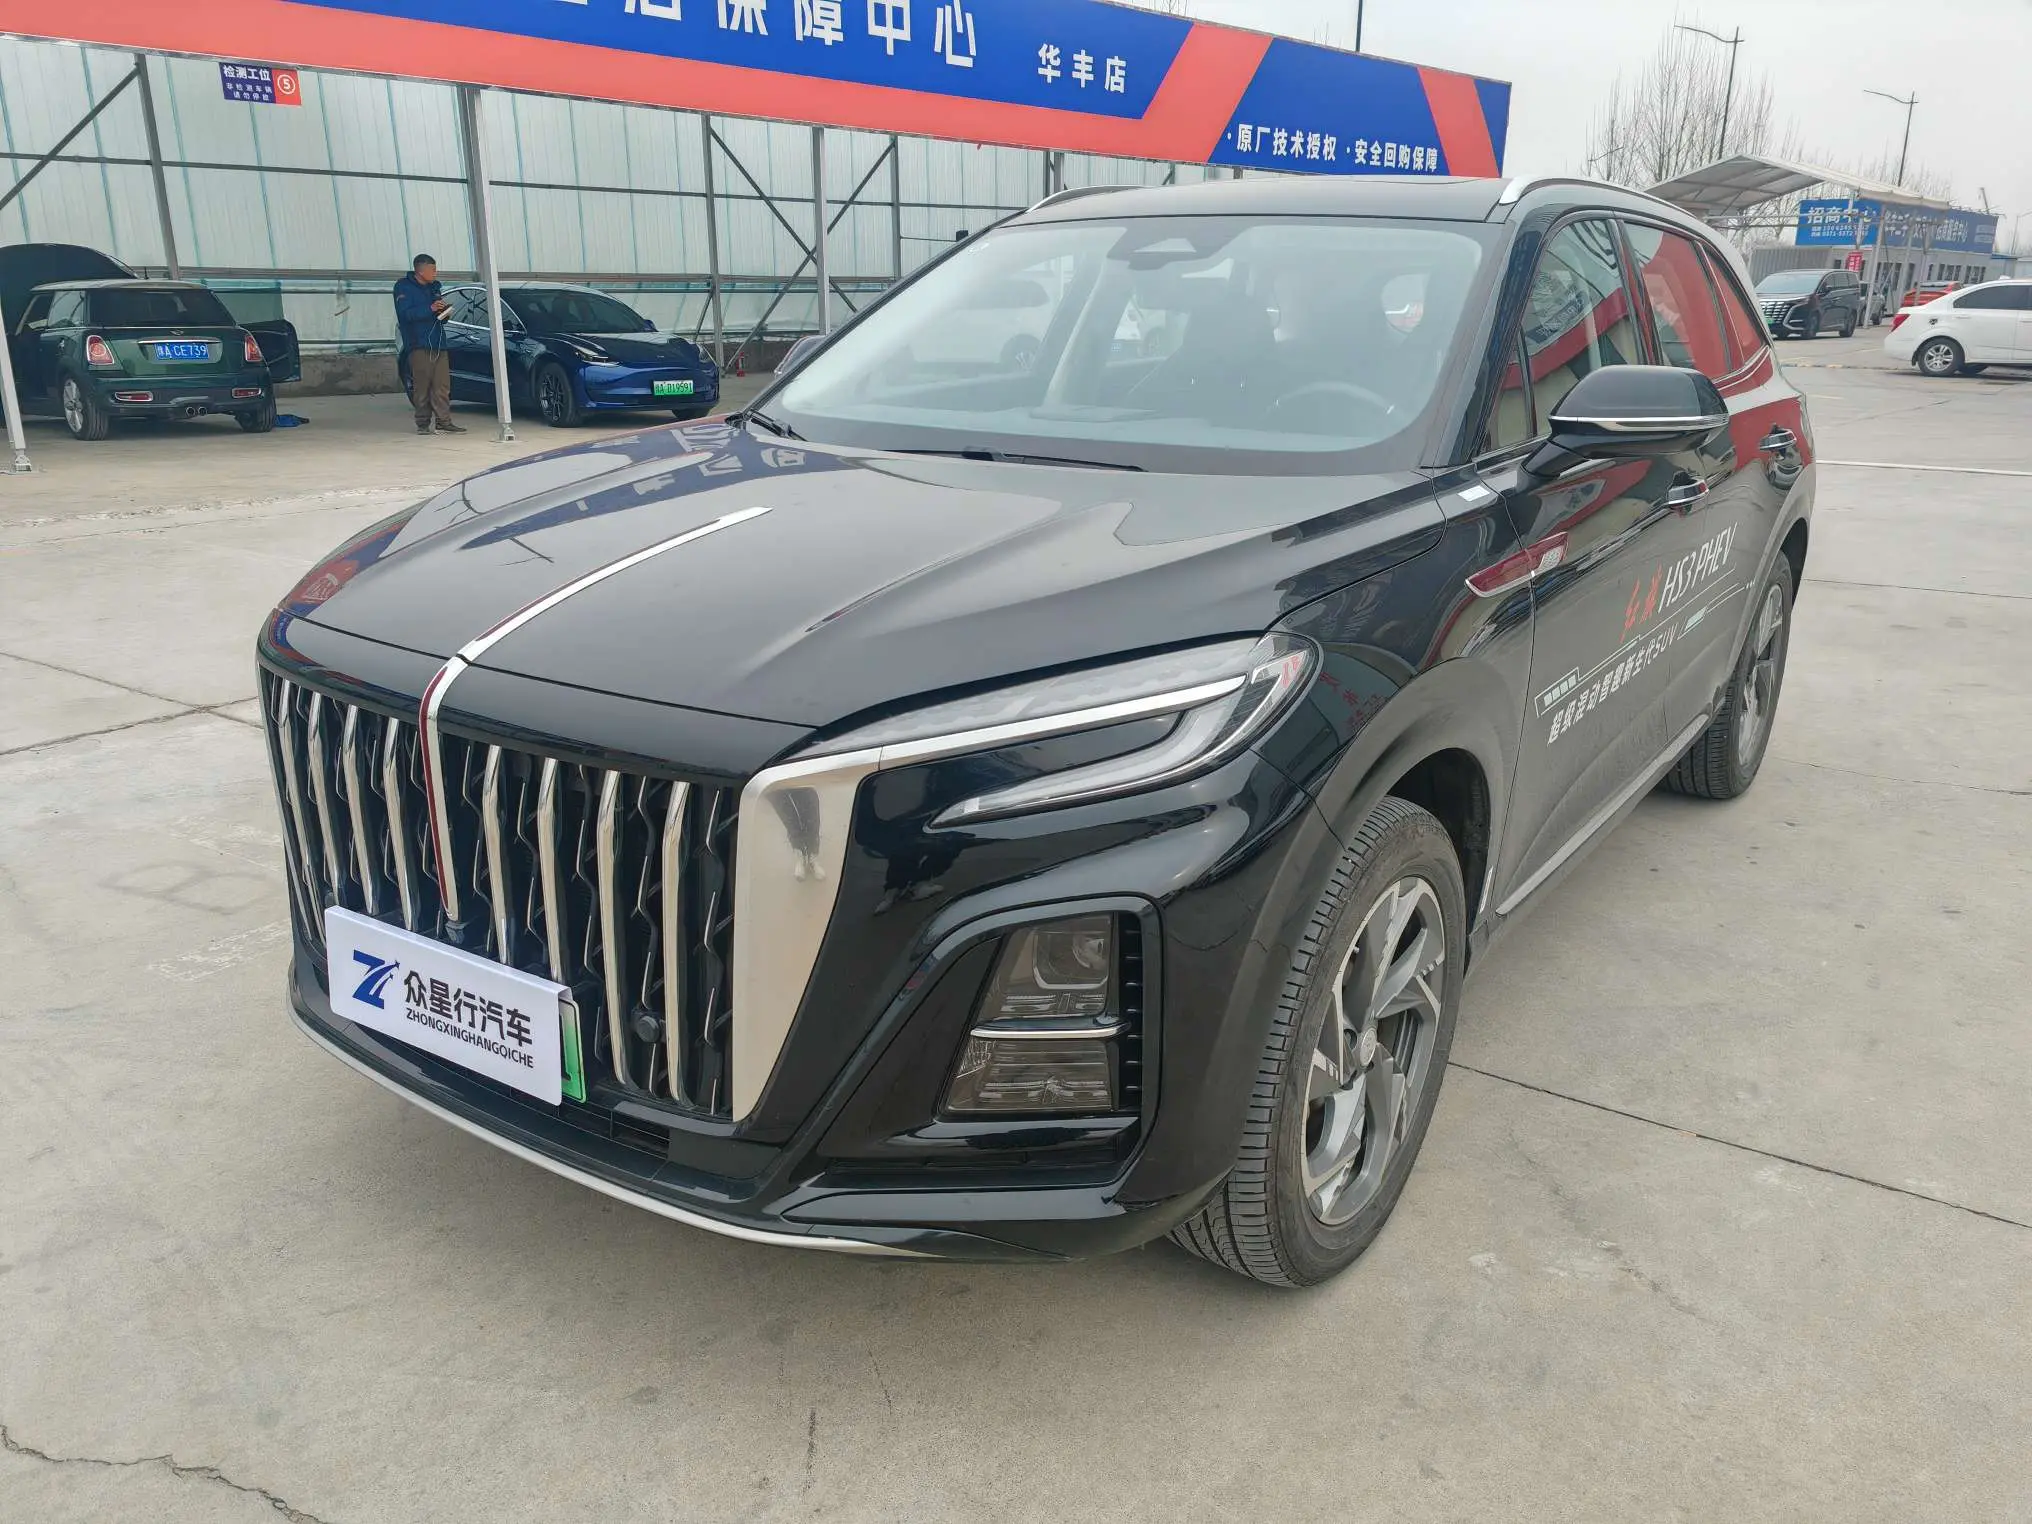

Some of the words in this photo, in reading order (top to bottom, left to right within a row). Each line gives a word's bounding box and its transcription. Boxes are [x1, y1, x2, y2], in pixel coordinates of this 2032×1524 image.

[223, 65, 271, 81] 检测工位
[1038, 43, 1127, 94] 华丰店
[1236, 123, 1337, 162] 原厂技术授权
[1354, 138, 1438, 173] 安全回购保障
[1658, 551, 1697, 613] HS3
[1691, 521, 1738, 589] PHEV
[404, 970, 533, 1047] 众星行汽车
[406, 1007, 534, 1069] ZHONGXINGHANGQICHE
